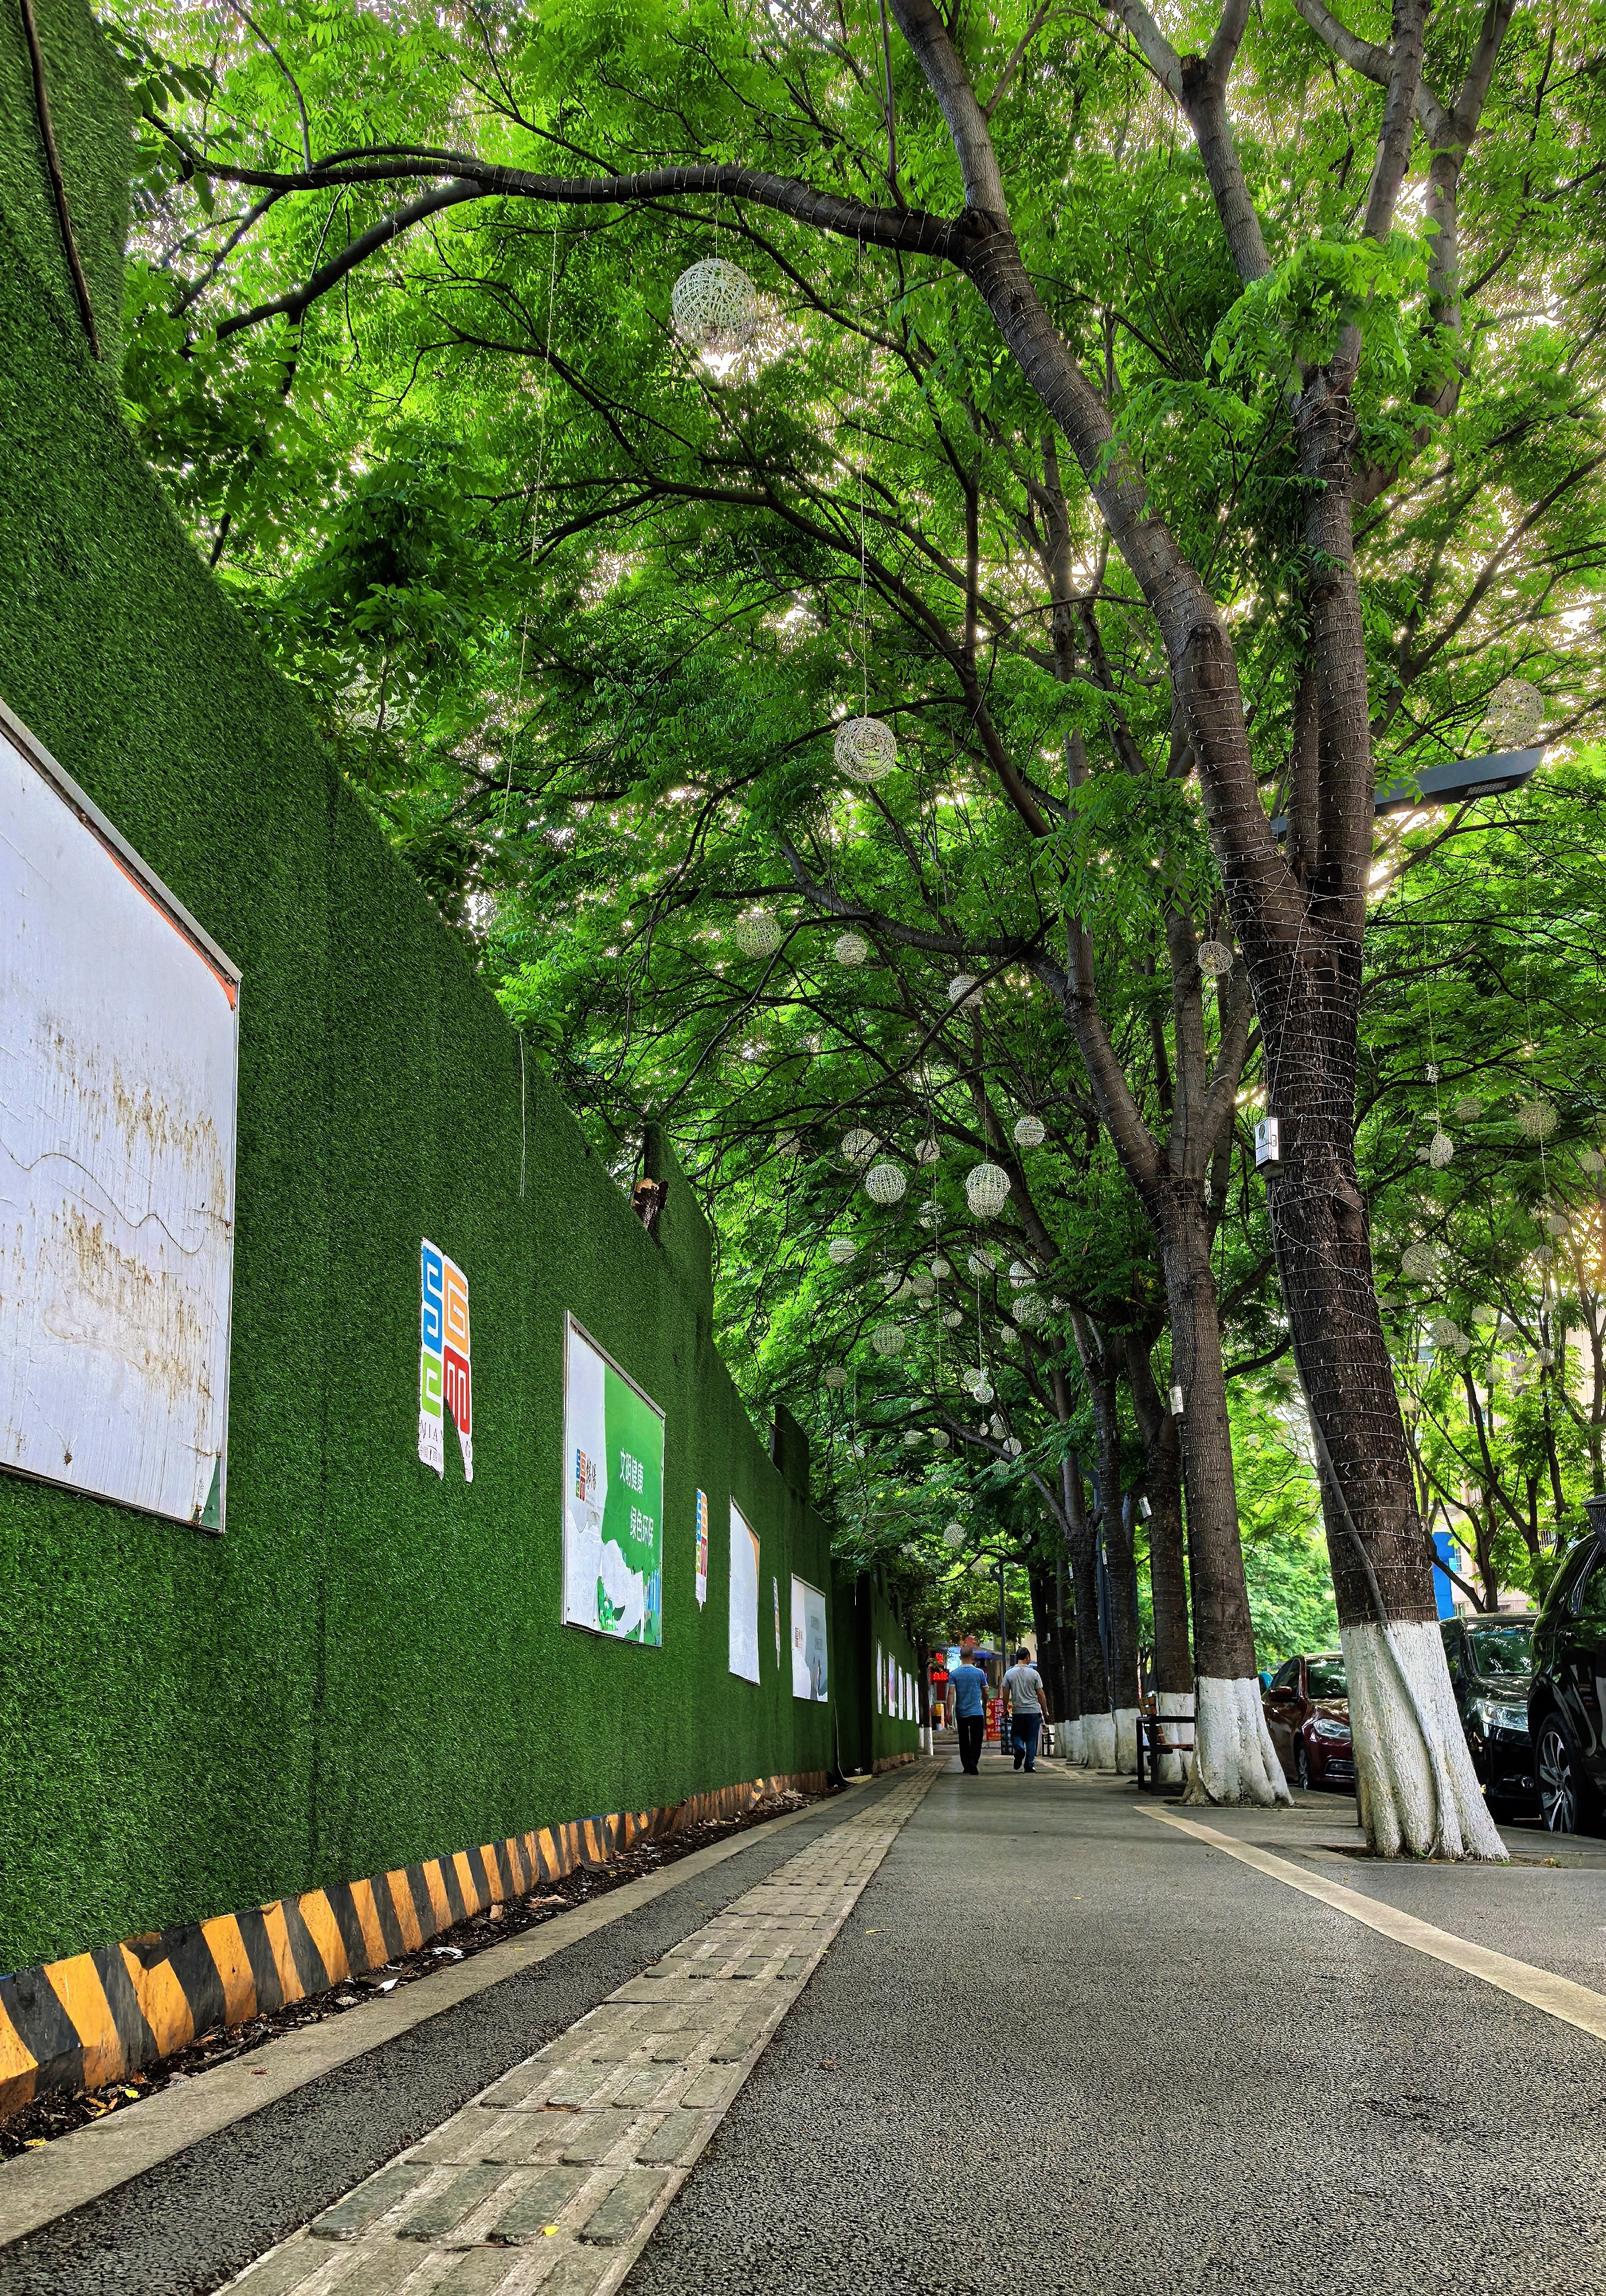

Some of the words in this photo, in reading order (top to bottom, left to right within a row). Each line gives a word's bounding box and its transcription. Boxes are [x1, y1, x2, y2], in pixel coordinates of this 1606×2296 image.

[620, 1447, 644, 1495] 文明健康
[630, 1504, 654, 1549] 绿色环保
